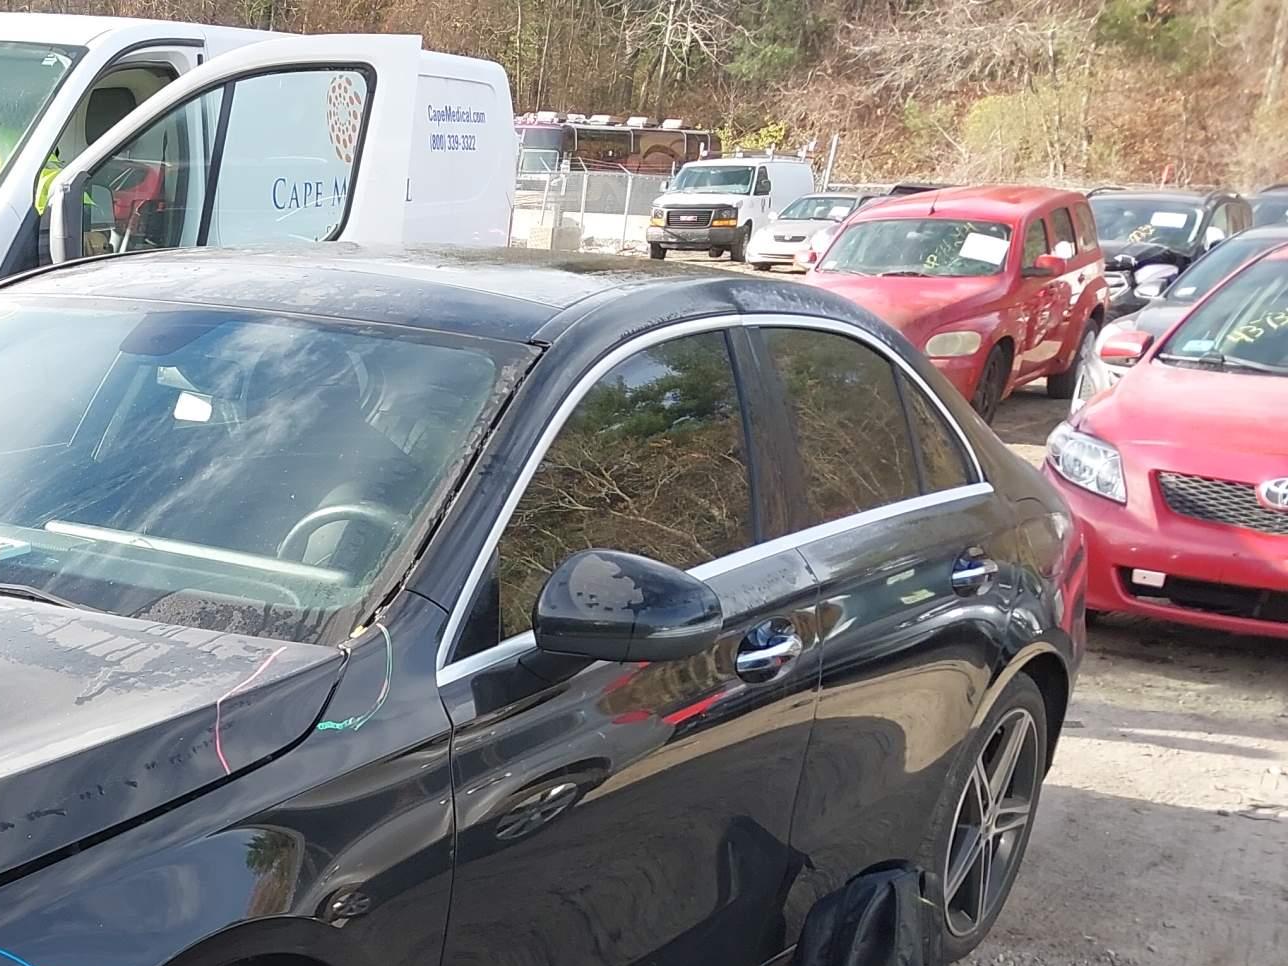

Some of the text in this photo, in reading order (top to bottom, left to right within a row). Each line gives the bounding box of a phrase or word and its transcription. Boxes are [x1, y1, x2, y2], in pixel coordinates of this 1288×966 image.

[427, 105, 486, 124] CapeMedical.com
[429, 134, 476, 152] (800) 339-3322
